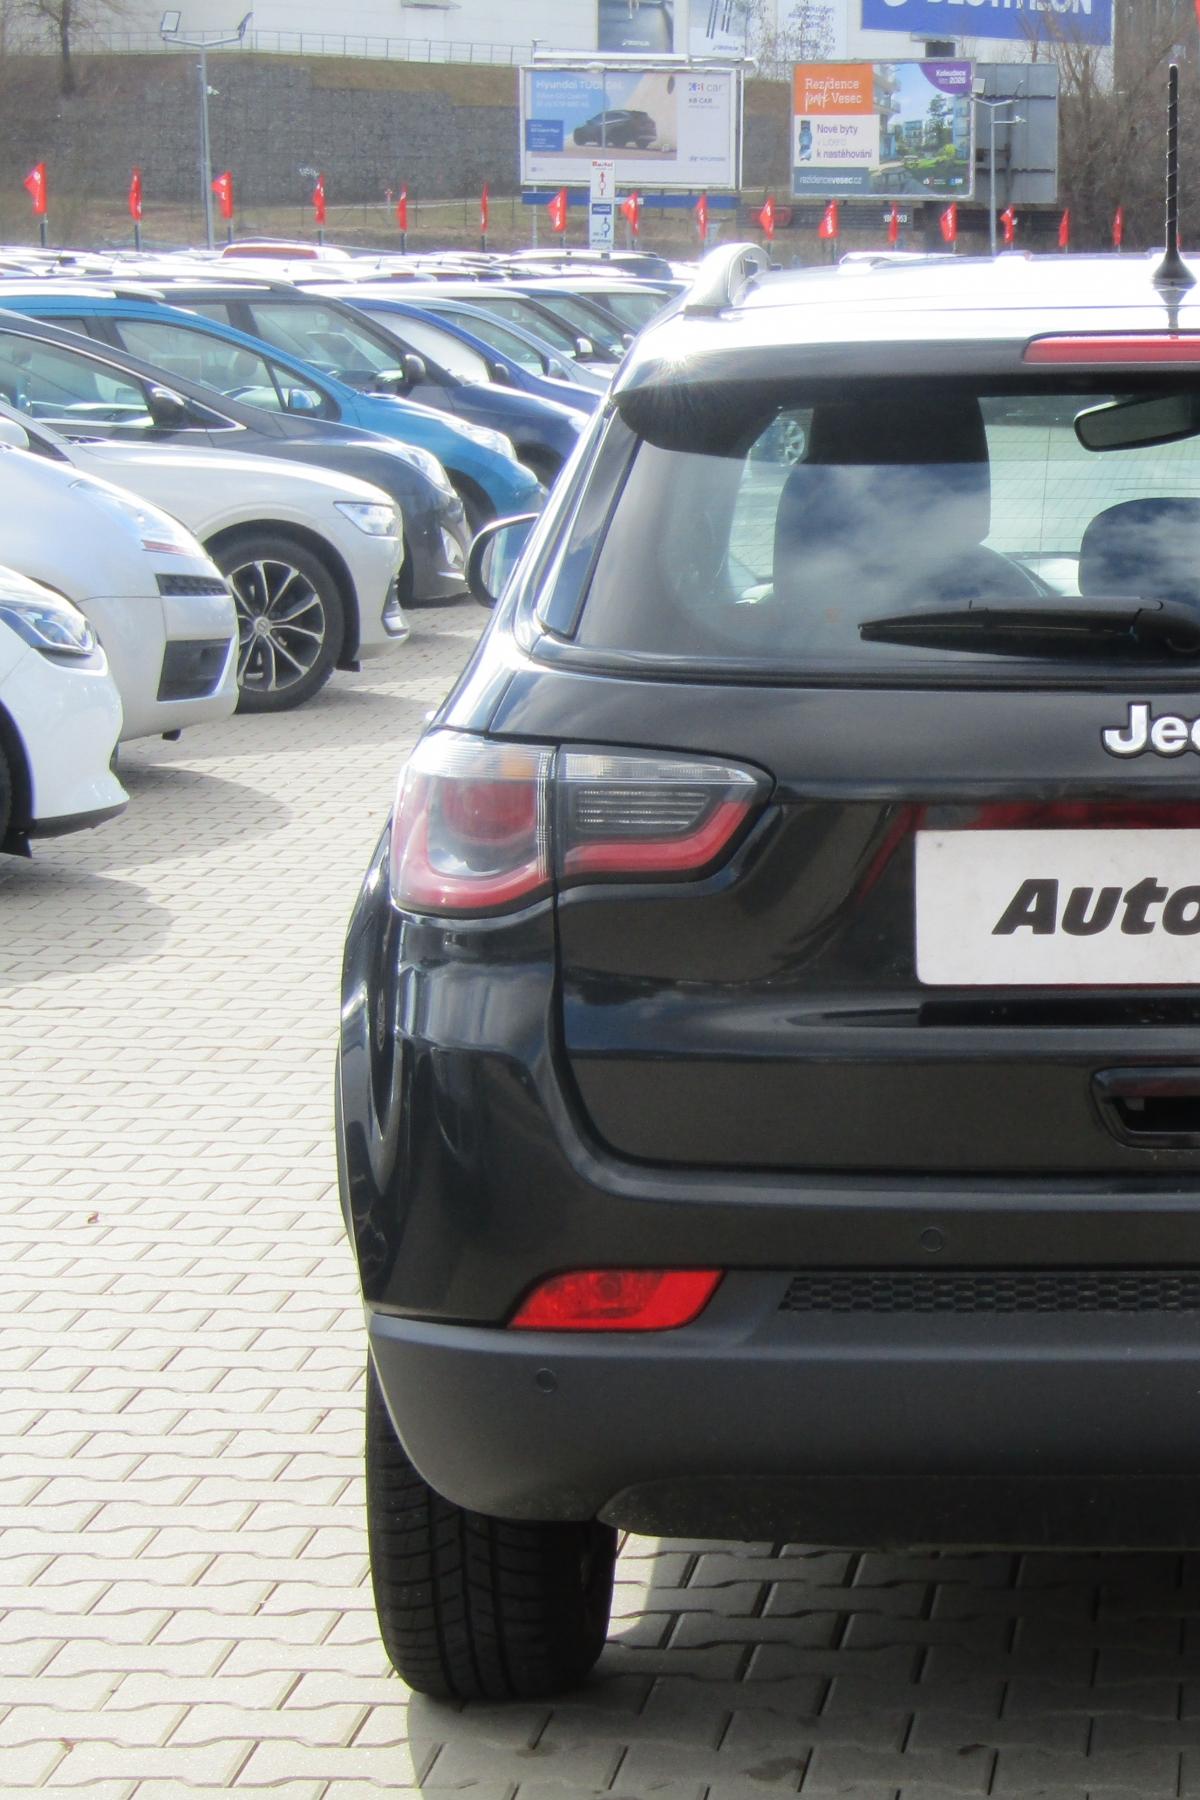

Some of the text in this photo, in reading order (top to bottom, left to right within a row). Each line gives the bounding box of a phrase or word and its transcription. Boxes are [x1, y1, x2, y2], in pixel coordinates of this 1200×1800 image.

[805, 77, 860, 89] Rezidence
[831, 92, 863, 104] Vesec
[816, 124, 858, 135] Nové byty
[823, 149, 872, 159] nastěhování
